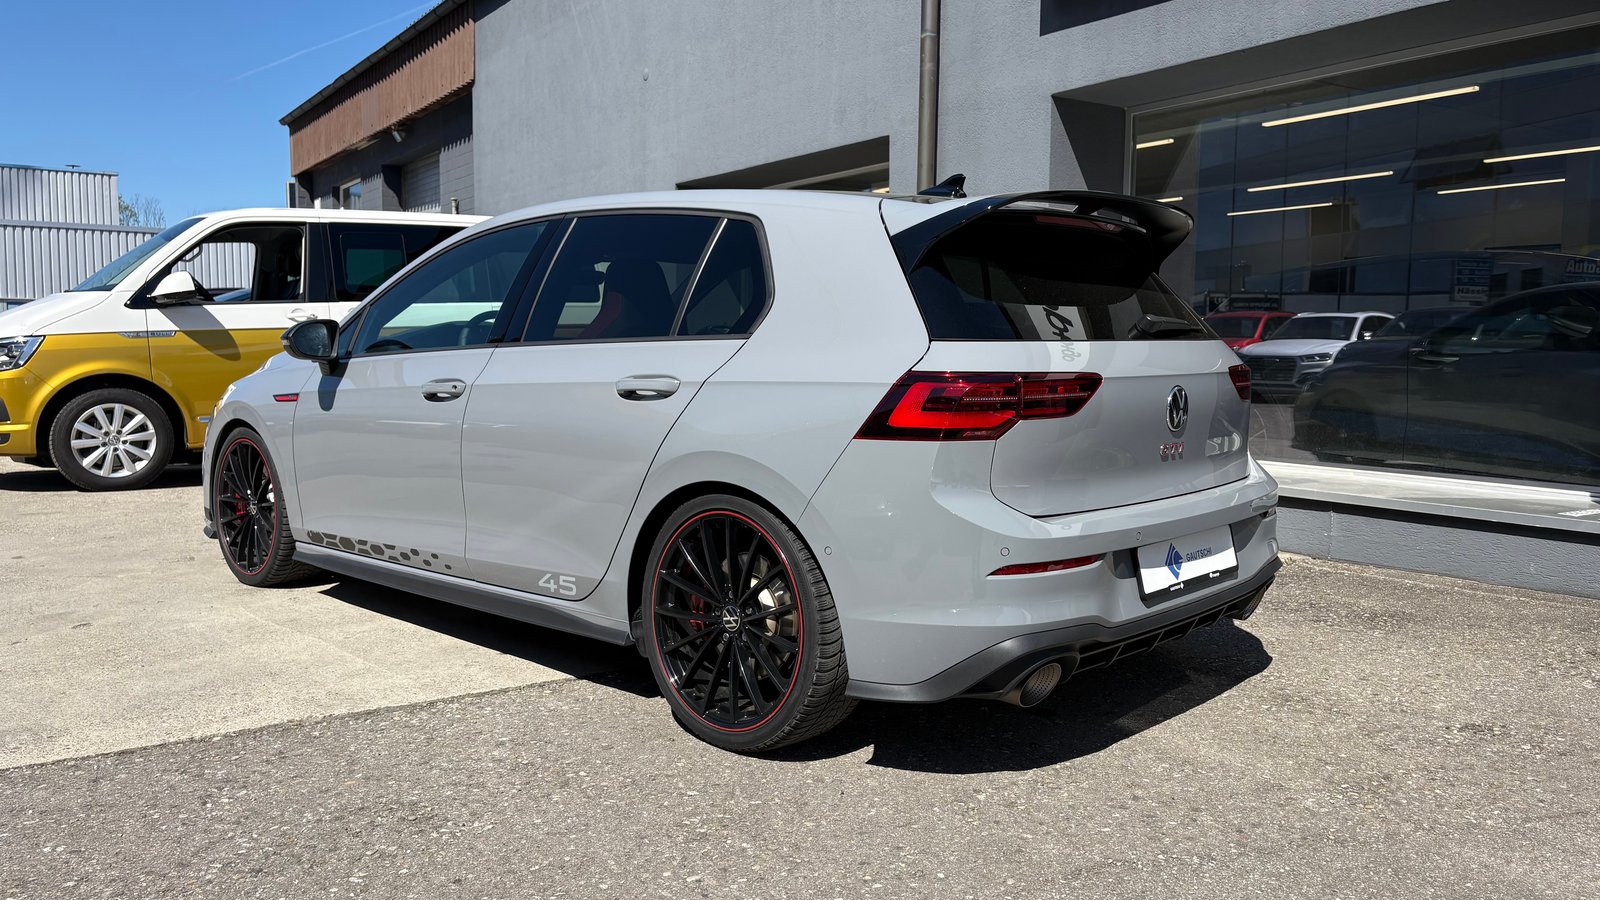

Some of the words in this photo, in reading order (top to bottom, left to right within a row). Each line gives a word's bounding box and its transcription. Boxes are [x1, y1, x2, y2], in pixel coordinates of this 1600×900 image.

[1160, 442, 1184, 456] GTI
[1186, 546, 1212, 562] GAUTSCHI
[538, 573, 577, 596] 45
